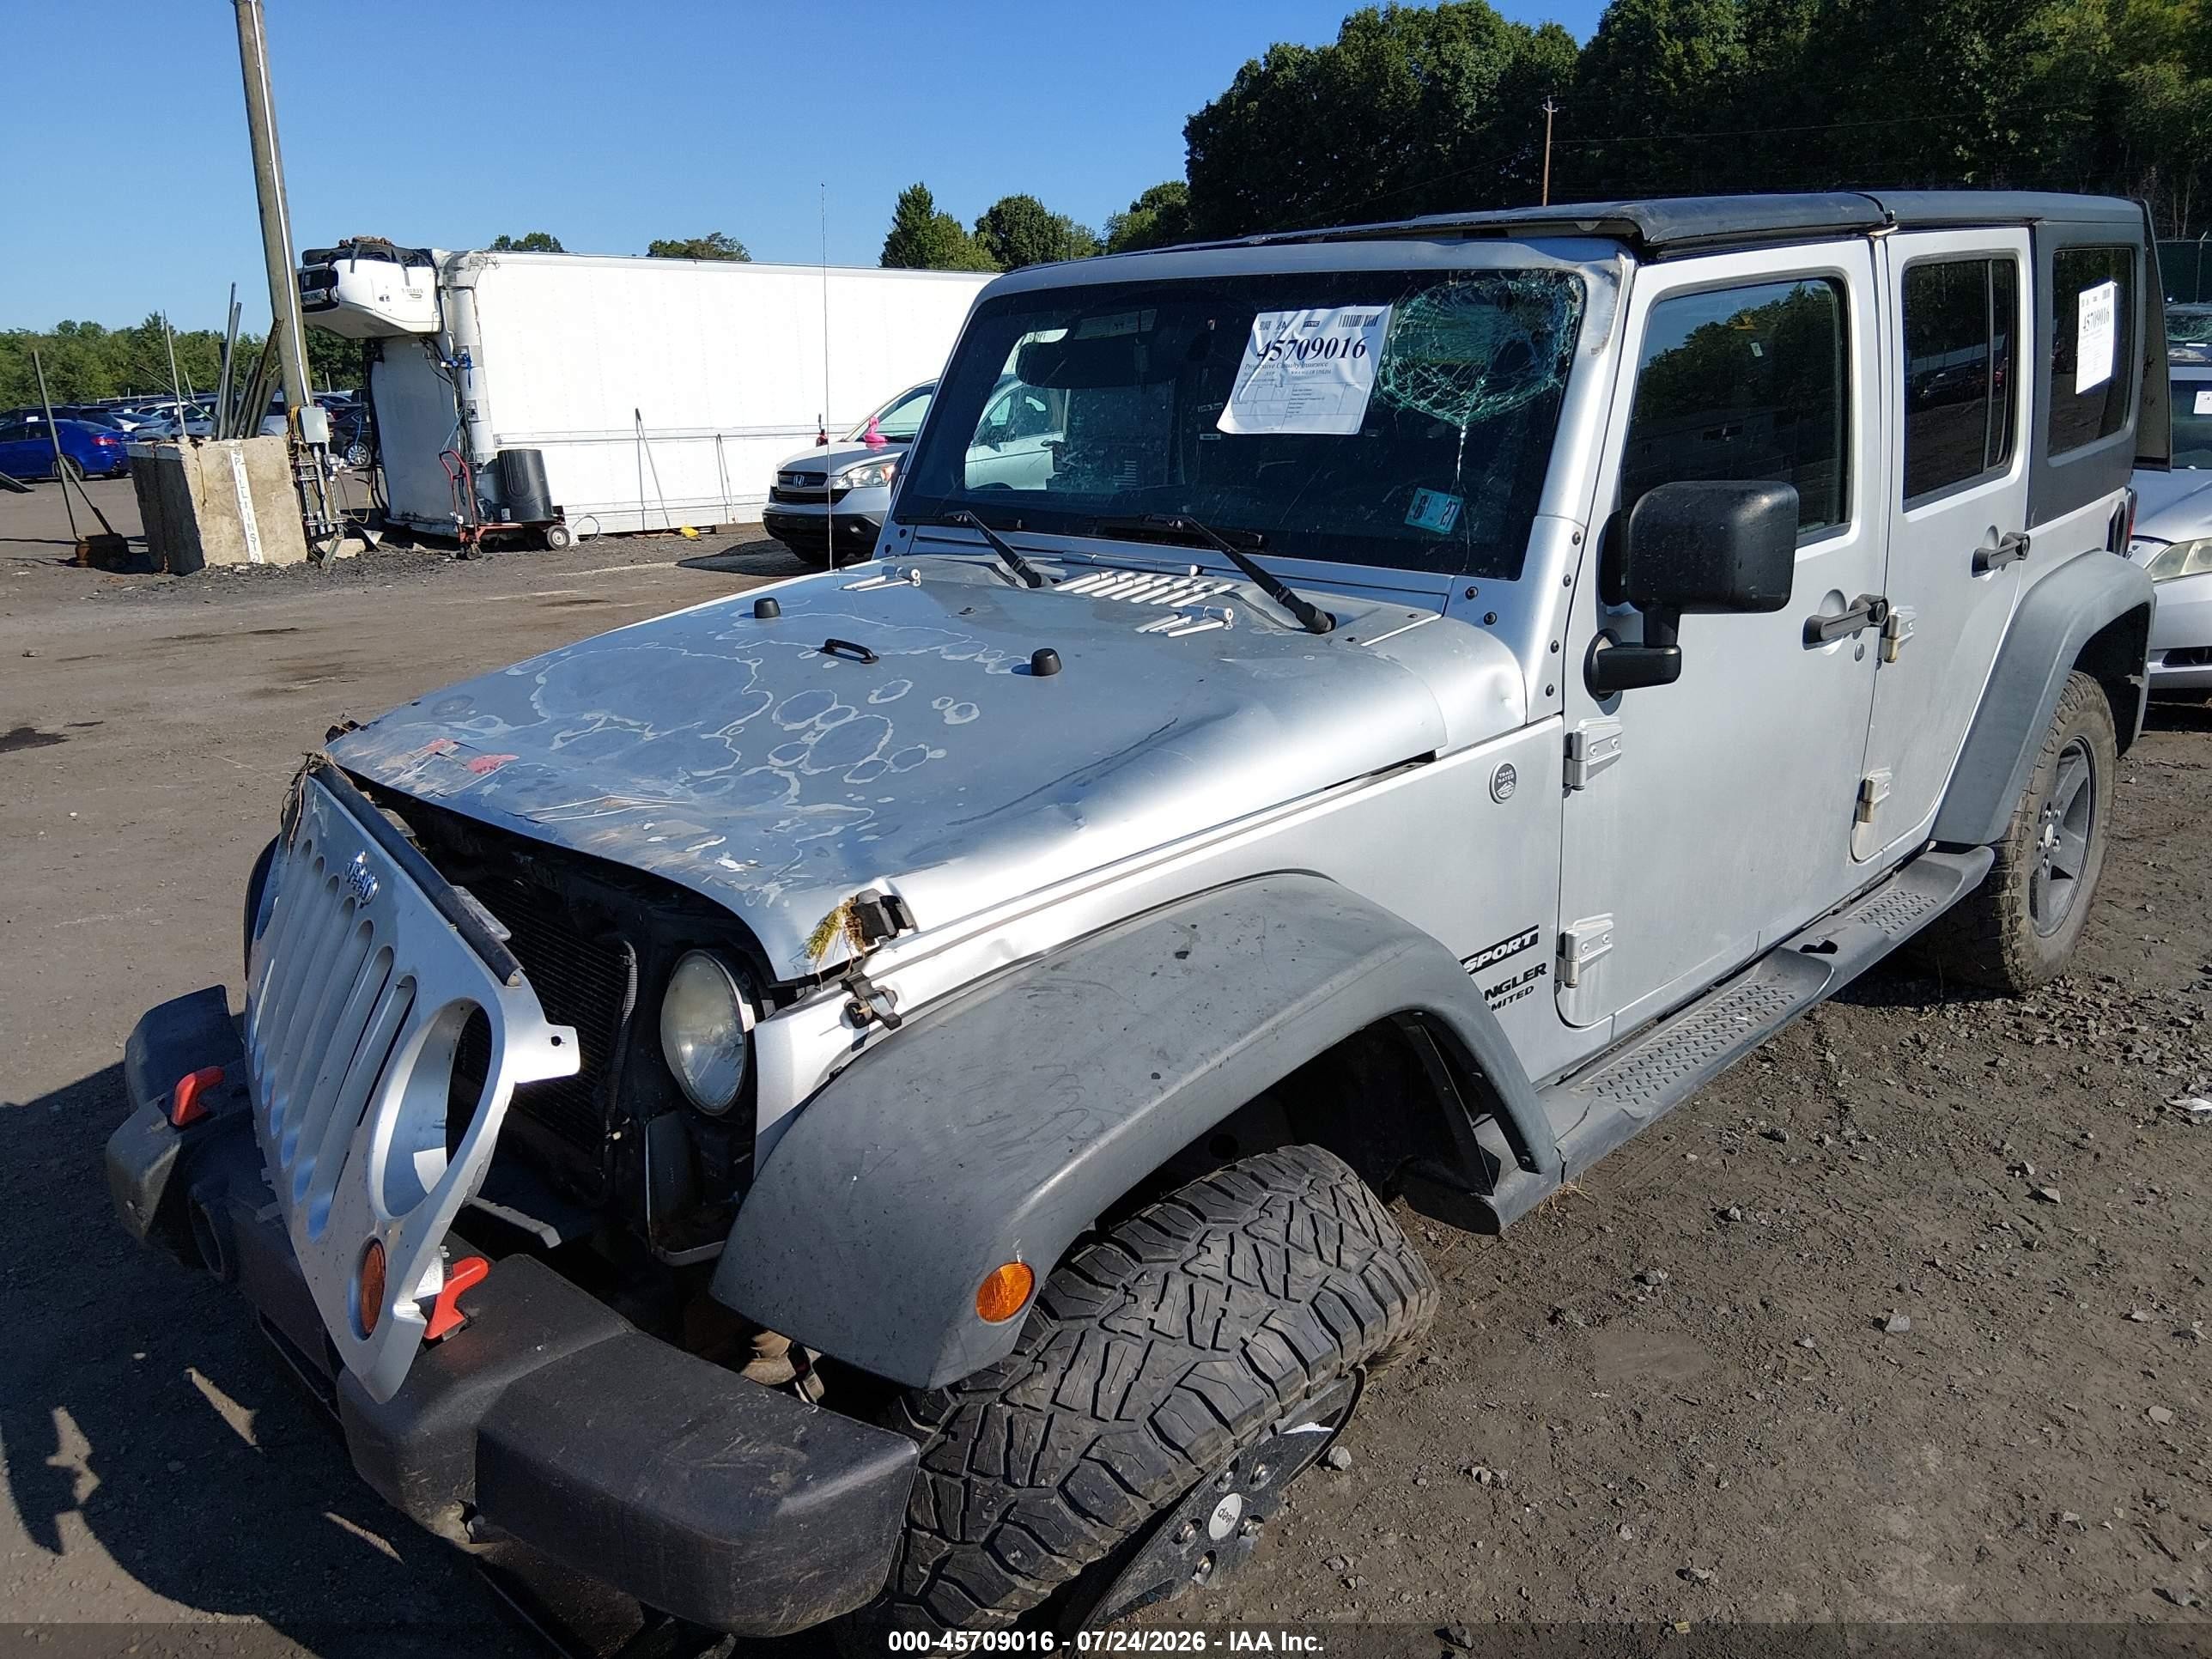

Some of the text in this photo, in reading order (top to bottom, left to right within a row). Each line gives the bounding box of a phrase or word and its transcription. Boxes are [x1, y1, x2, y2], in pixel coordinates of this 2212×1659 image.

[2082, 307, 2110, 332] 45709016
[1257, 336, 1370, 362] 45709016
[1440, 501, 1458, 528] 27
[1462, 929, 1539, 972] SPORT
[1217, 1506, 1236, 1527] Jeep
